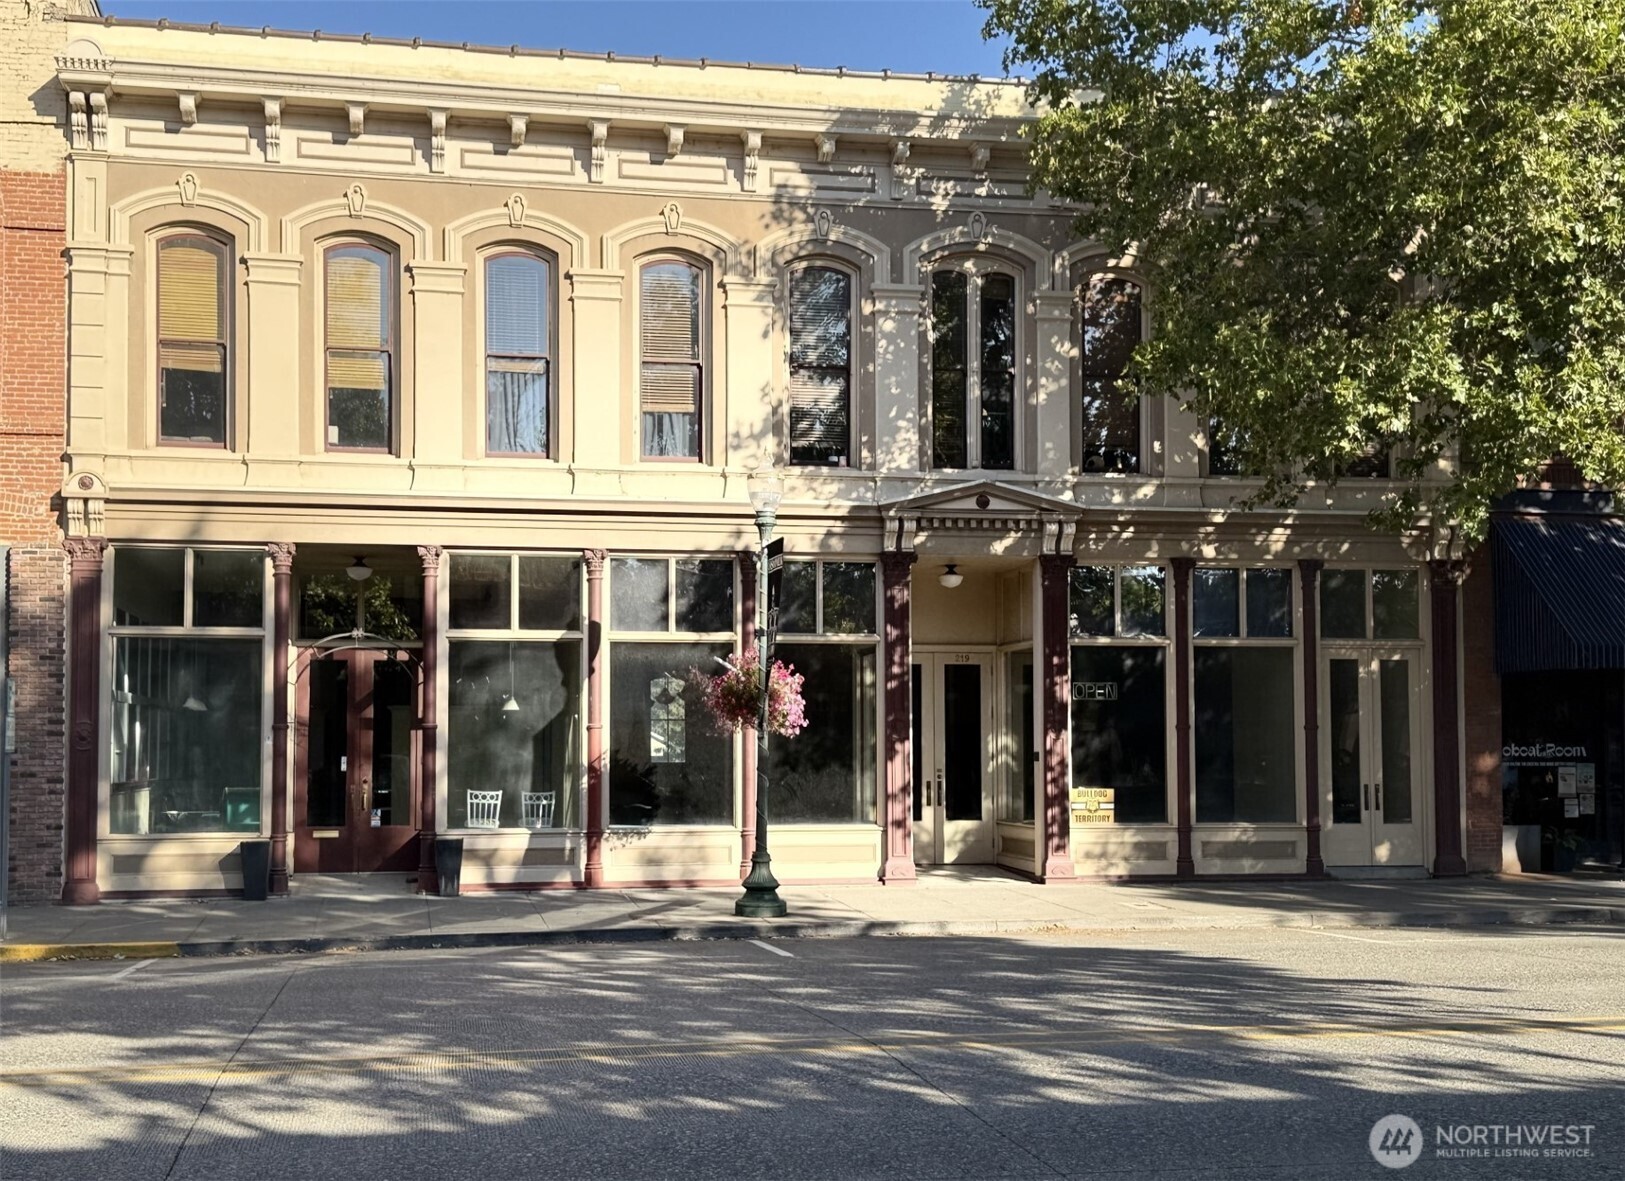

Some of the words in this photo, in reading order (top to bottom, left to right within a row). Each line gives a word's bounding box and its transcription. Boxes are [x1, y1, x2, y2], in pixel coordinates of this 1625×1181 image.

[955, 654, 970, 663] 219
[1075, 683, 1116, 699] OPEN
[1502, 743, 1541, 757] obcat
[1545, 743, 1587, 757] Room
[1077, 790, 1108, 798] BULLDOG
[1075, 815, 1111, 823] TERRITORY
